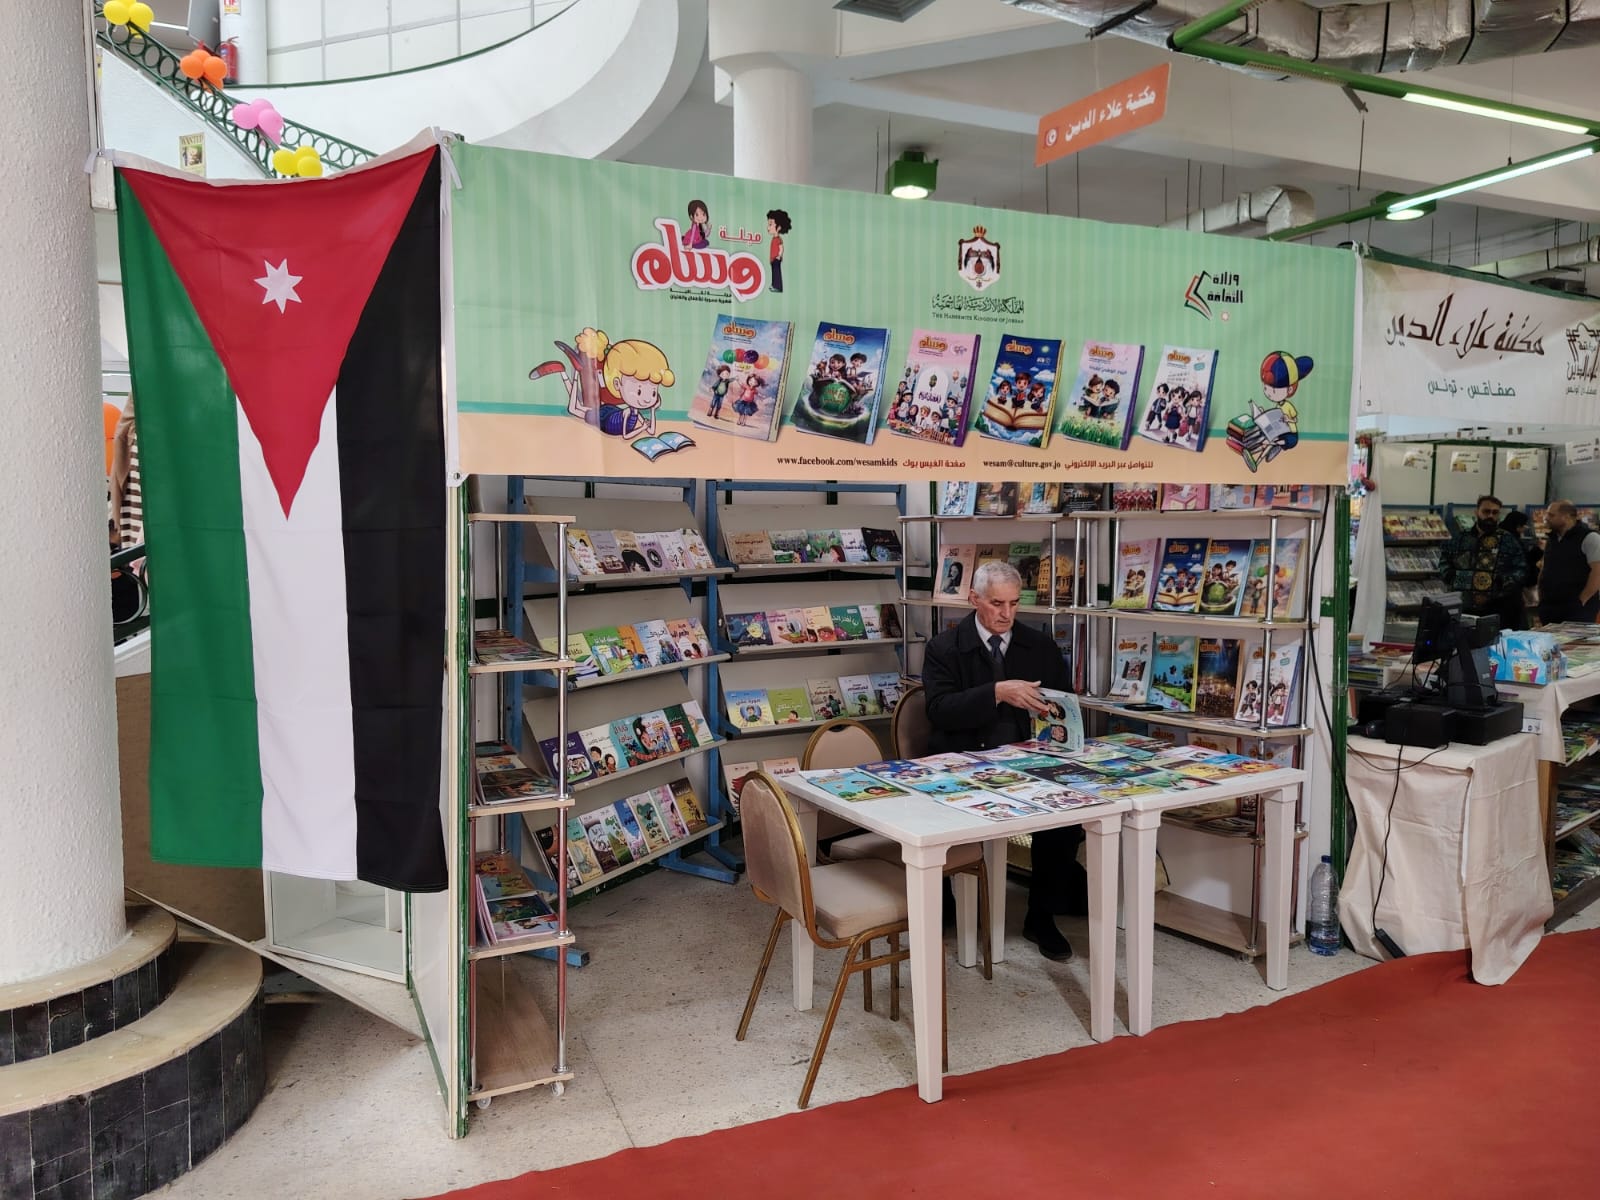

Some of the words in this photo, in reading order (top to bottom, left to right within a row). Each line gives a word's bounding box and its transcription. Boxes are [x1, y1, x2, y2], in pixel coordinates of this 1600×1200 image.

[1099, 99, 1123, 123] علاء
[1126, 85, 1156, 116] مكتبة
[1065, 108, 1097, 142] الدين
[719, 226, 762, 245] مجلة
[635, 222, 763, 298] وسام
[1207, 288, 1244, 304] الثقافة
[1385, 292, 1455, 347] الدين
[1449, 307, 1496, 359] علاء
[1494, 312, 1545, 360] مكتبة
[1427, 378, 1458, 397] تونس
[1467, 379, 1516, 399] صفاقس
[776, 456, 898, 467] www.facebook.com/wesamkids
[982, 459, 1061, 470] wesam@culture.gov.jo
